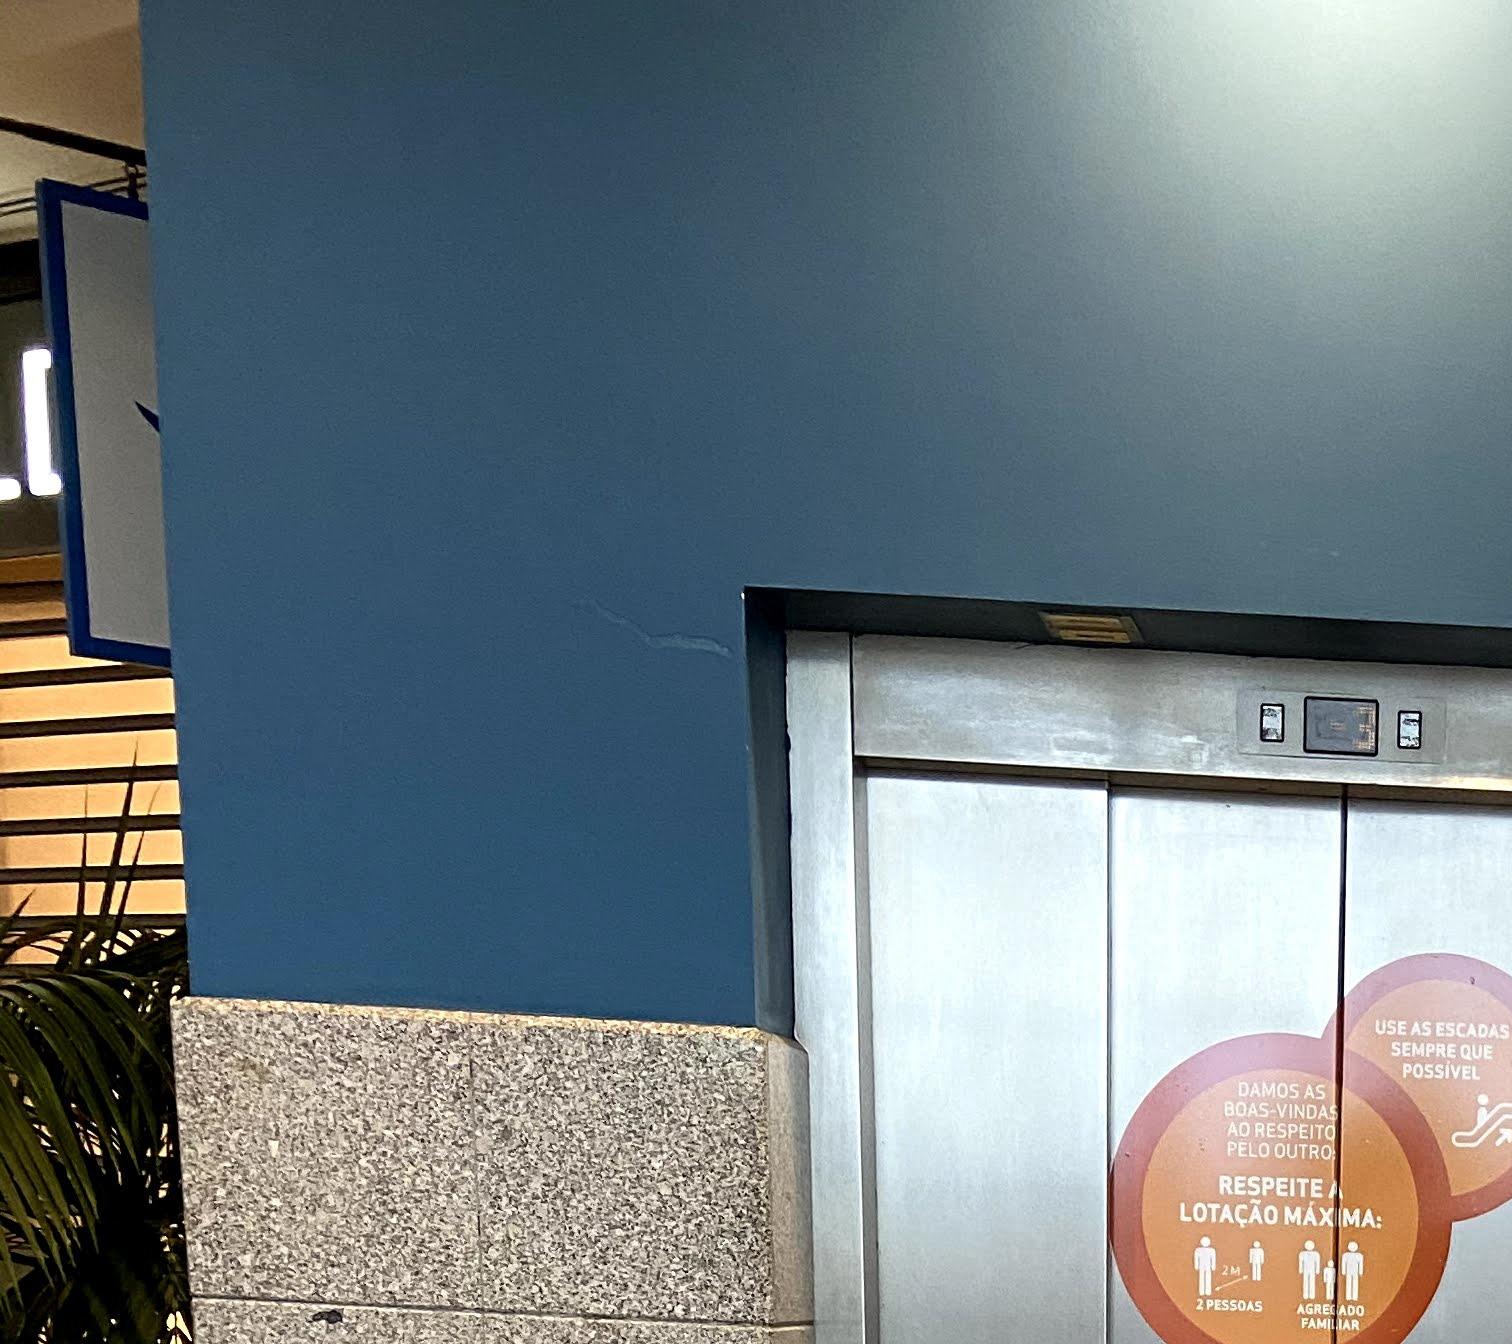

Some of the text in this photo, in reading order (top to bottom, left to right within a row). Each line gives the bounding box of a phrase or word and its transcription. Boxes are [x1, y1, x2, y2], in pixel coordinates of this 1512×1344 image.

[1375, 1020, 1510, 1040] USE AS ESCADAS
[1391, 1042, 1493, 1061] SEMPRE QUE
[1402, 1060, 1481, 1081] POSSÍVEL
[1238, 1081, 1326, 1100] DAMOS AS
[1224, 1101, 1338, 1121] BOAS-VINDAS
[1227, 1123, 1337, 1141] AO RESPEITO
[1227, 1142, 1271, 1158] PELO
[1218, 1175, 1324, 1198] RESPEITE
[1180, 1199, 1280, 1230] LOTAÇÃO
[1195, 1298, 1263, 1313] 2 PESSOAS
